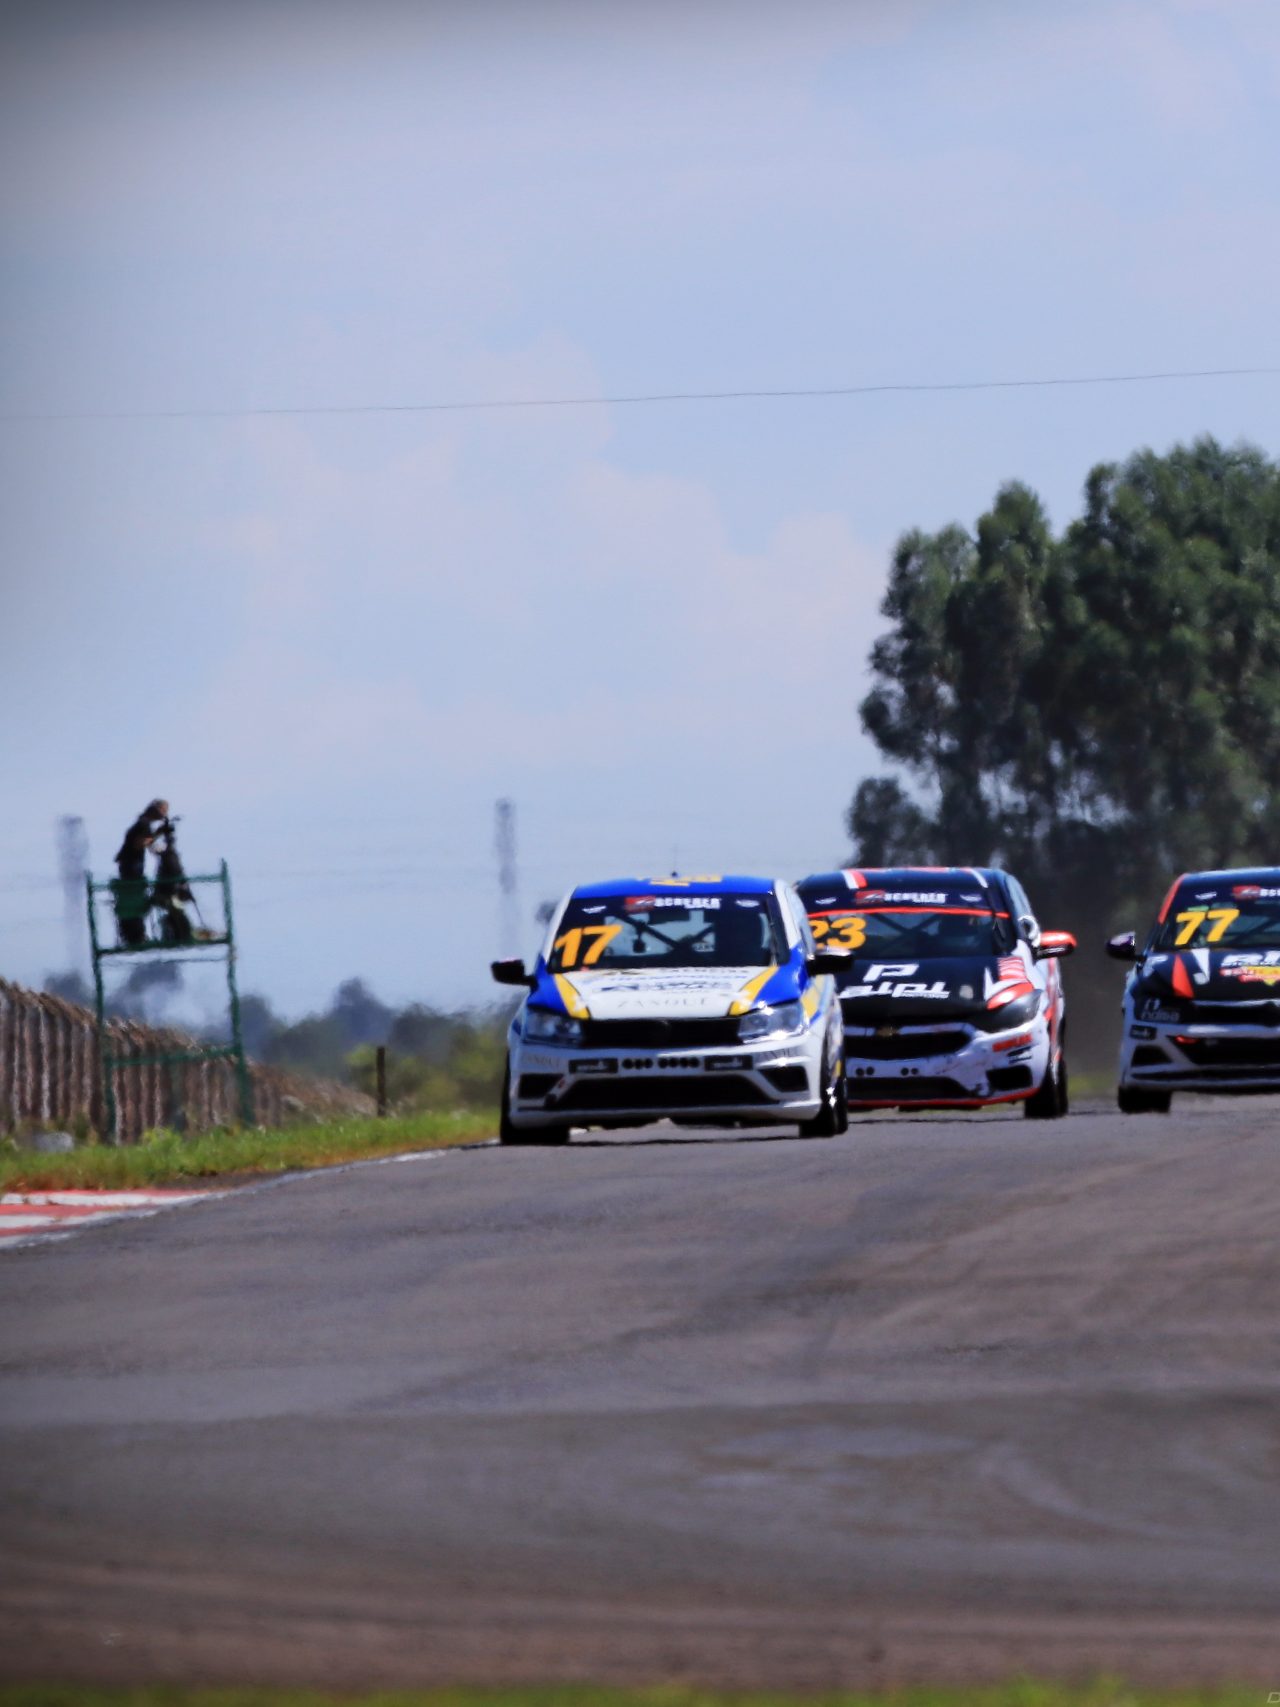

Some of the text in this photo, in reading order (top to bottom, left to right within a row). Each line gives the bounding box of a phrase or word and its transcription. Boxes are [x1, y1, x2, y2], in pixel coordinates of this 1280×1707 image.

[554, 925, 622, 967] 17
[808, 917, 866, 949] 23
[1174, 908, 1240, 946] 77
